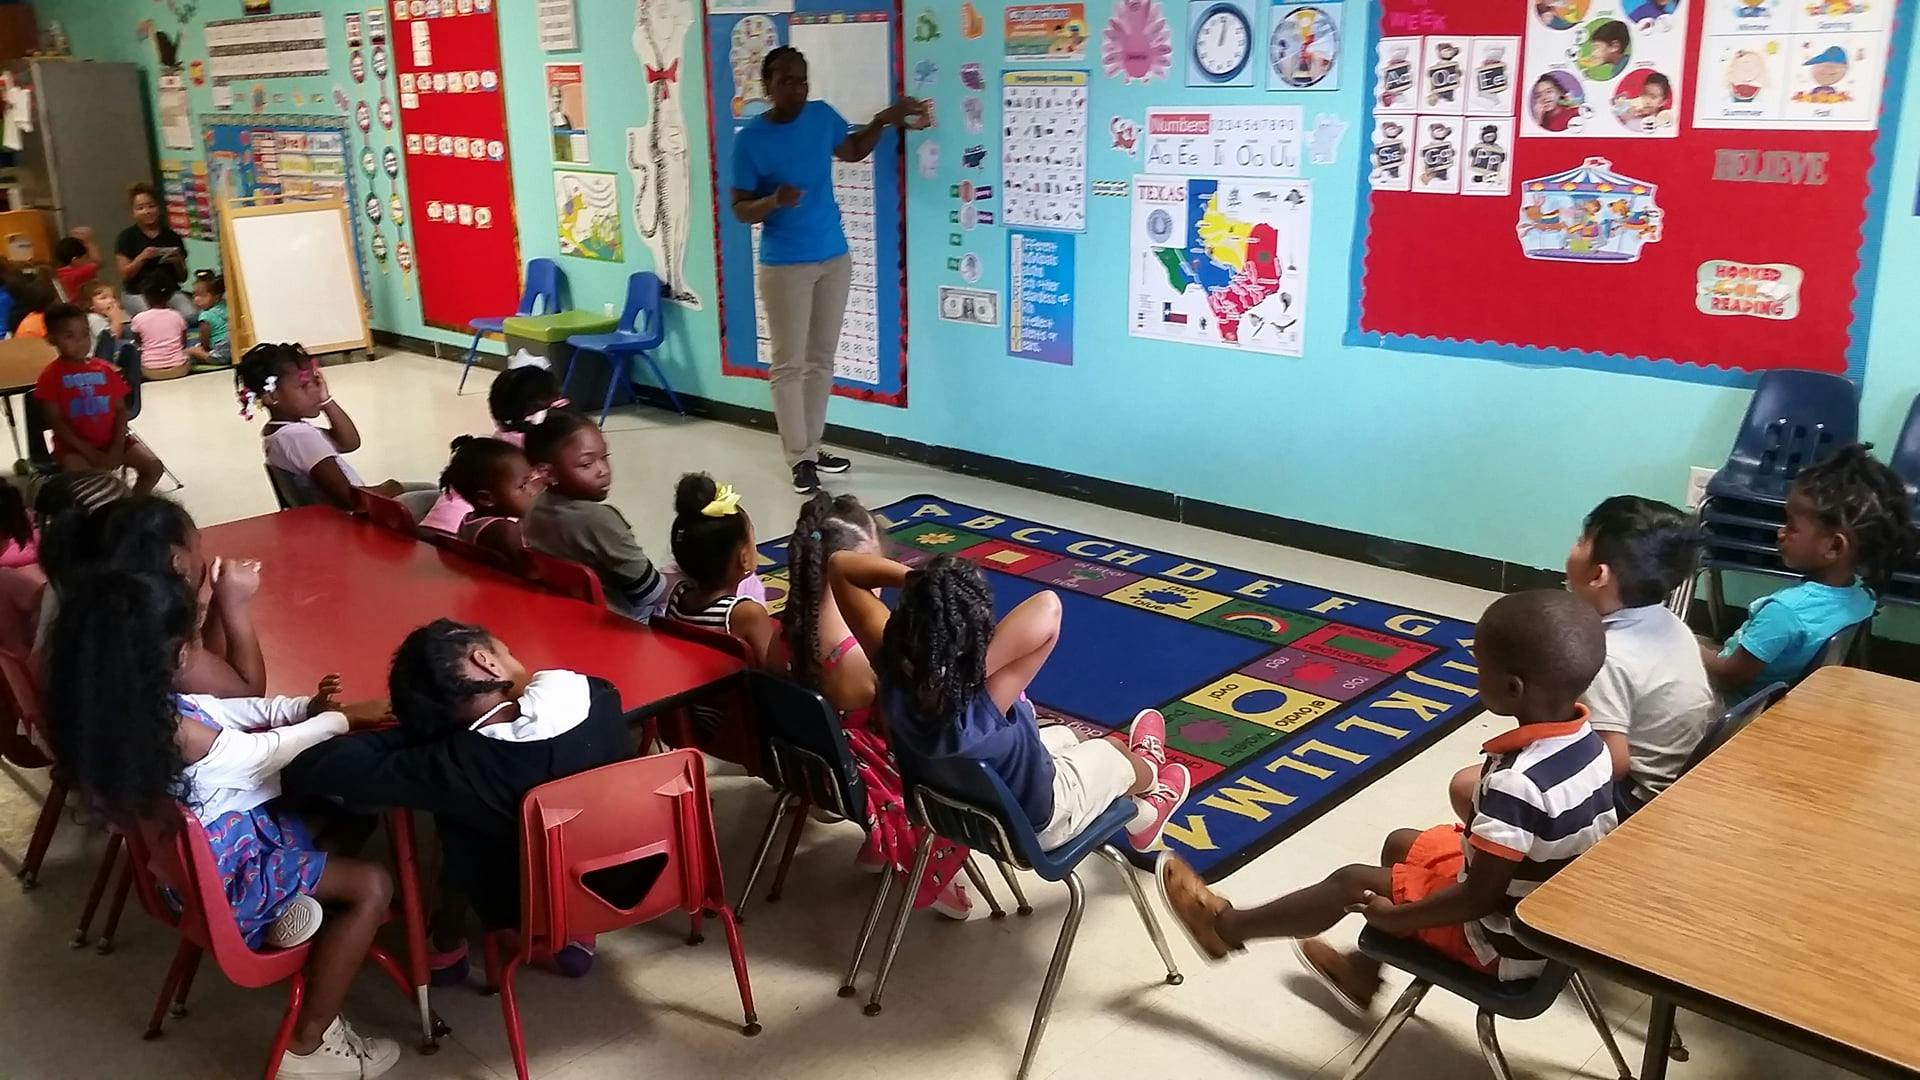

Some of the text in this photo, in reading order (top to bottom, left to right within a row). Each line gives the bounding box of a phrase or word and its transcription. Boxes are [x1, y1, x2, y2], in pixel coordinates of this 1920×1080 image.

[1151, 116, 1208, 133] Numbers
[1712, 149, 1830, 185] BELIEVE
[1138, 185, 1184, 201] TEXAS
[1715, 265, 1781, 281] HOOKED
[1711, 297, 1784, 315] READING
[911, 504, 952, 517] A
[958, 515, 1006, 529] B
[1010, 527, 1060, 543] C
[1066, 540, 1150, 567] CH
[1159, 562, 1218, 582] D
[1234, 580, 1284, 598] E
[1306, 596, 1360, 614] F
[1384, 614, 1442, 637] G
[1167, 583, 1199, 596] azul
[1132, 598, 1167, 611] blue
[1265, 655, 1290, 669] red
[1208, 682, 1240, 700] oval
[1406, 671, 1480, 698] J
[1368, 690, 1454, 722] K
[1334, 715, 1412, 740] L
[1197, 776, 1299, 822] M
